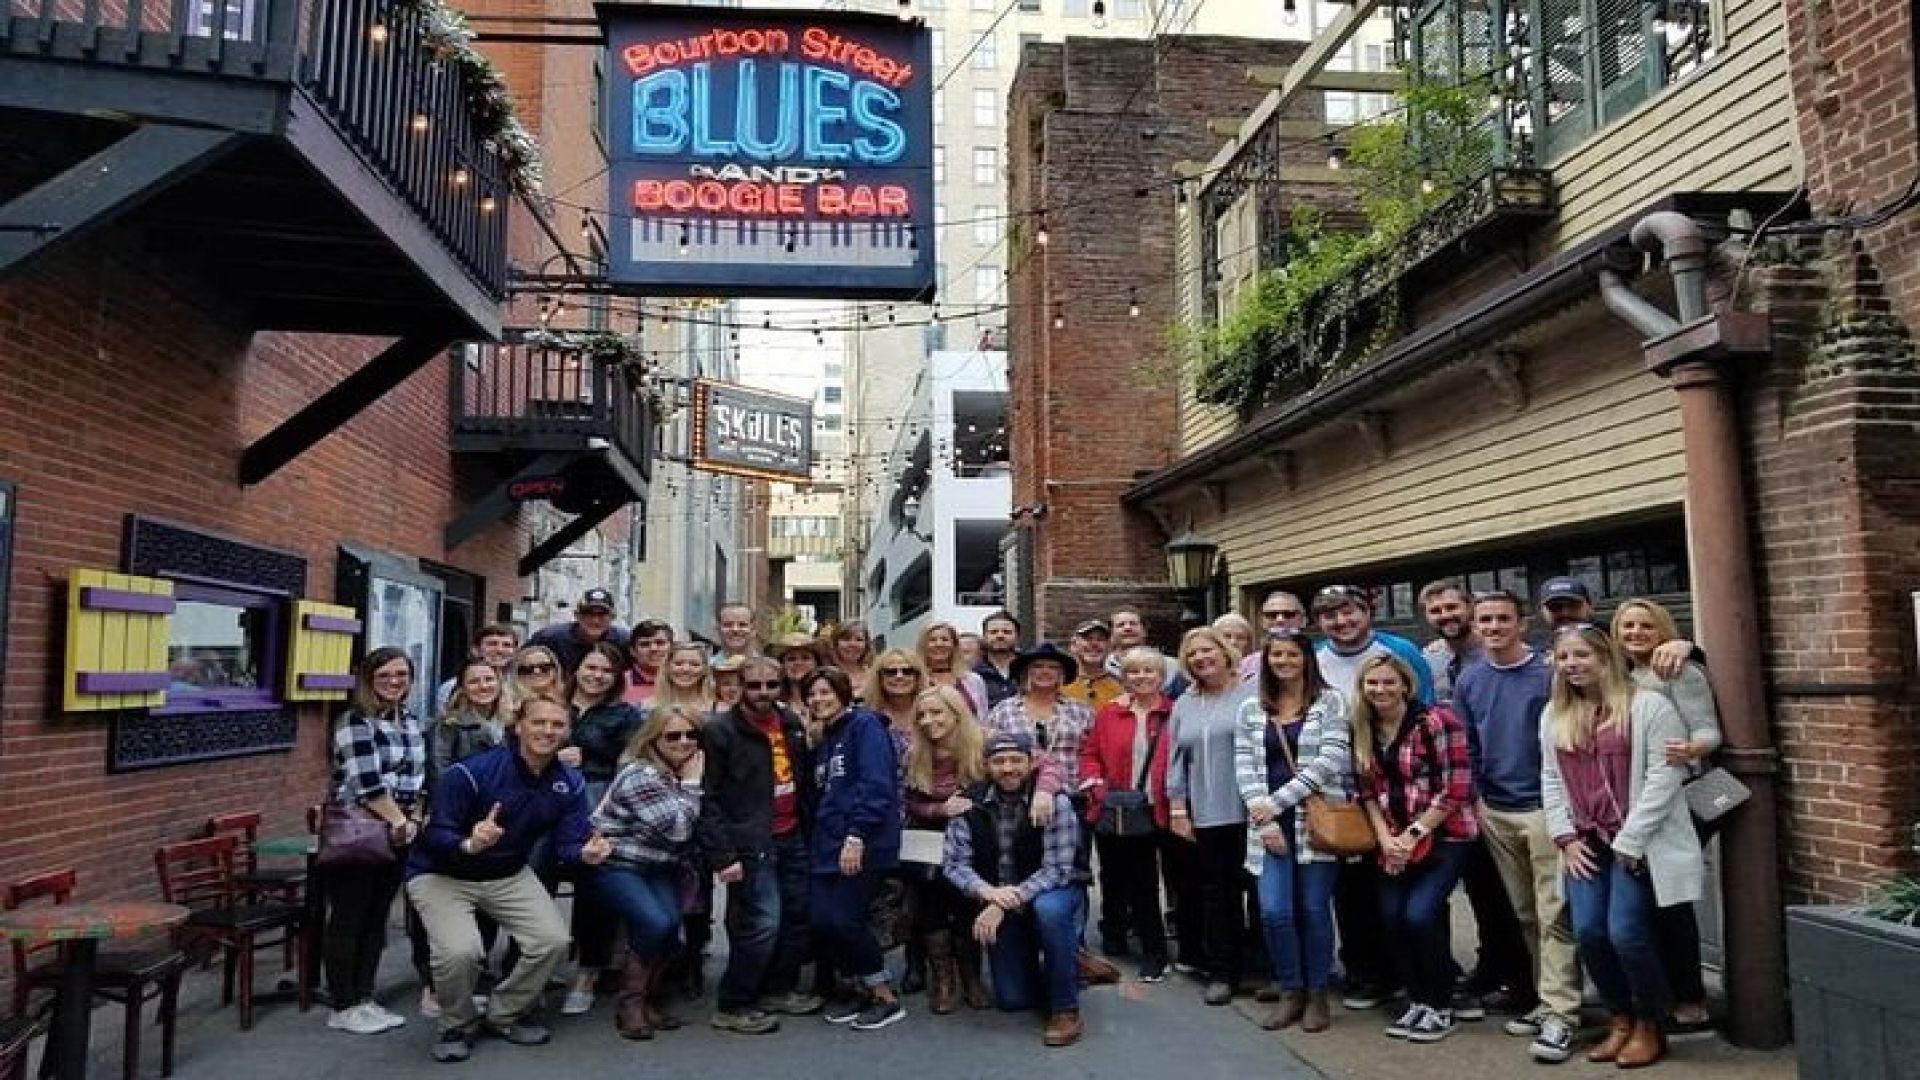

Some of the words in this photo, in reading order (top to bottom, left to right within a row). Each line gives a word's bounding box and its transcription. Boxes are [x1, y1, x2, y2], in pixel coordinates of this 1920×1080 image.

[623, 29, 788, 74] Bourbon
[801, 28, 912, 86] Street
[632, 58, 906, 163] BLUES
[715, 164, 819, 183] AND
[633, 179, 805, 214] BOOGIE
[817, 184, 911, 217] BAR
[510, 479, 564, 498] OPEN
